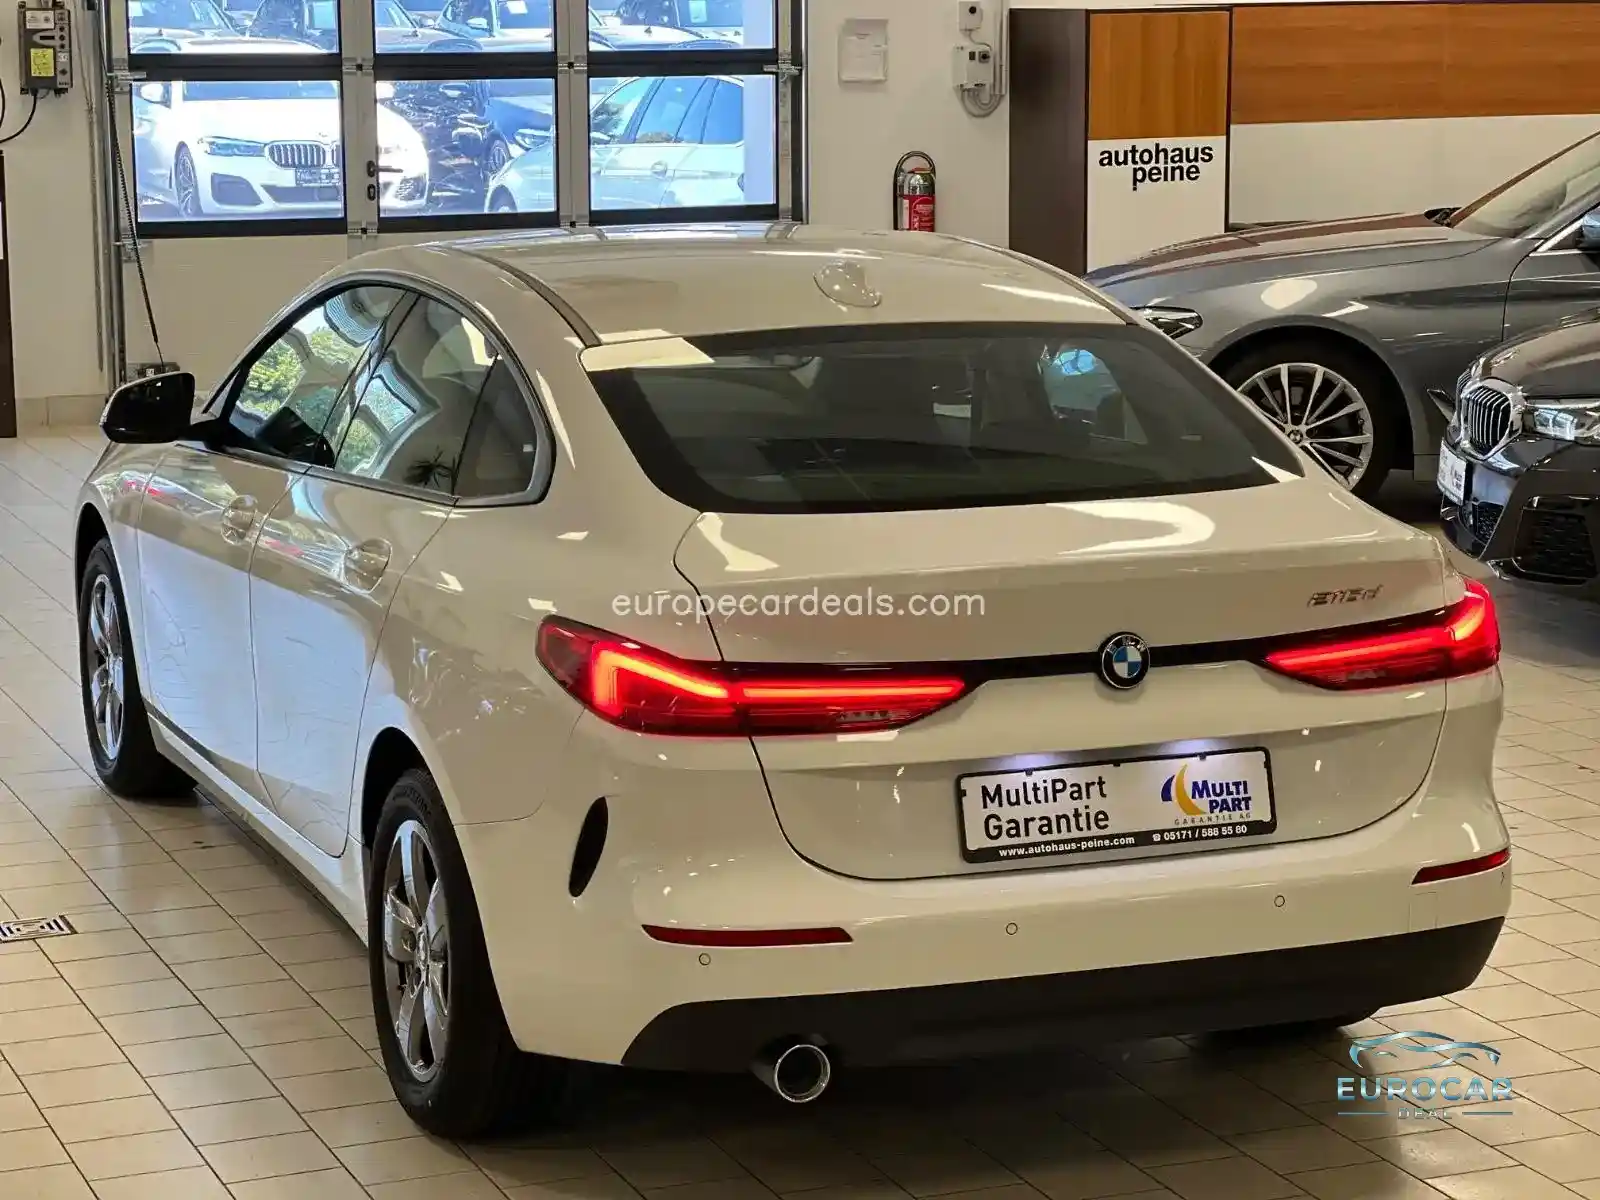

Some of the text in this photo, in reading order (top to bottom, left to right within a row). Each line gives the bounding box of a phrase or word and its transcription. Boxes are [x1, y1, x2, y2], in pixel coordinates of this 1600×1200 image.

[1099, 143, 1214, 166] autohaus
[1132, 161, 1201, 191] peine
[981, 776, 1107, 809] MultiPart
[1208, 796, 1252, 814] PART
[984, 805, 1110, 841] Garantie
[1174, 812, 1251, 826] GARANTIE AG
[1163, 830, 1193, 841] 05171
[1221, 826, 1234, 835] 55
[998, 836, 1135, 857] www.autohaus-peine.com
